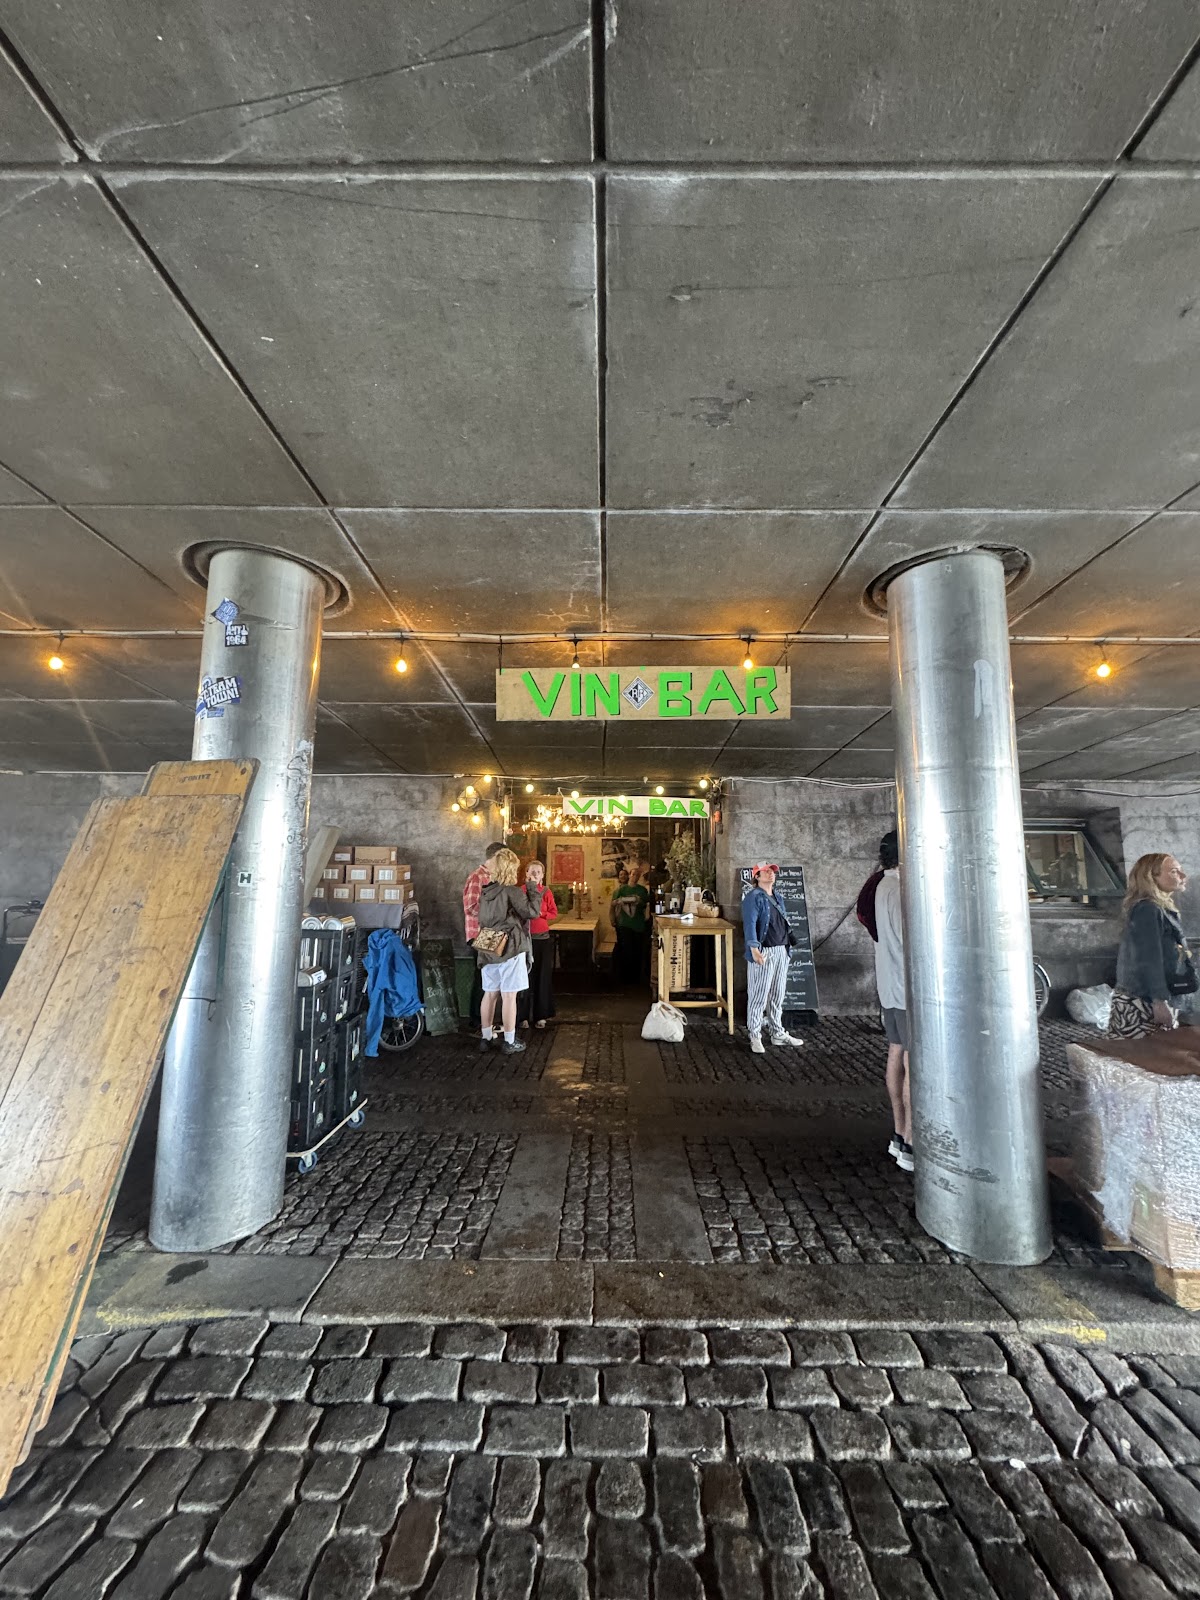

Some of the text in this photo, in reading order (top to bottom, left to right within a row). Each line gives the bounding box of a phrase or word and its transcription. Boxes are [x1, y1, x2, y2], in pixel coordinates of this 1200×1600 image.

[206, 688, 240, 708] TOWN!
[521, 671, 620, 717] VIN
[658, 667, 779, 717] BAR
[568, 799, 708, 817] VIN BAR
[239, 873, 252, 884] H
